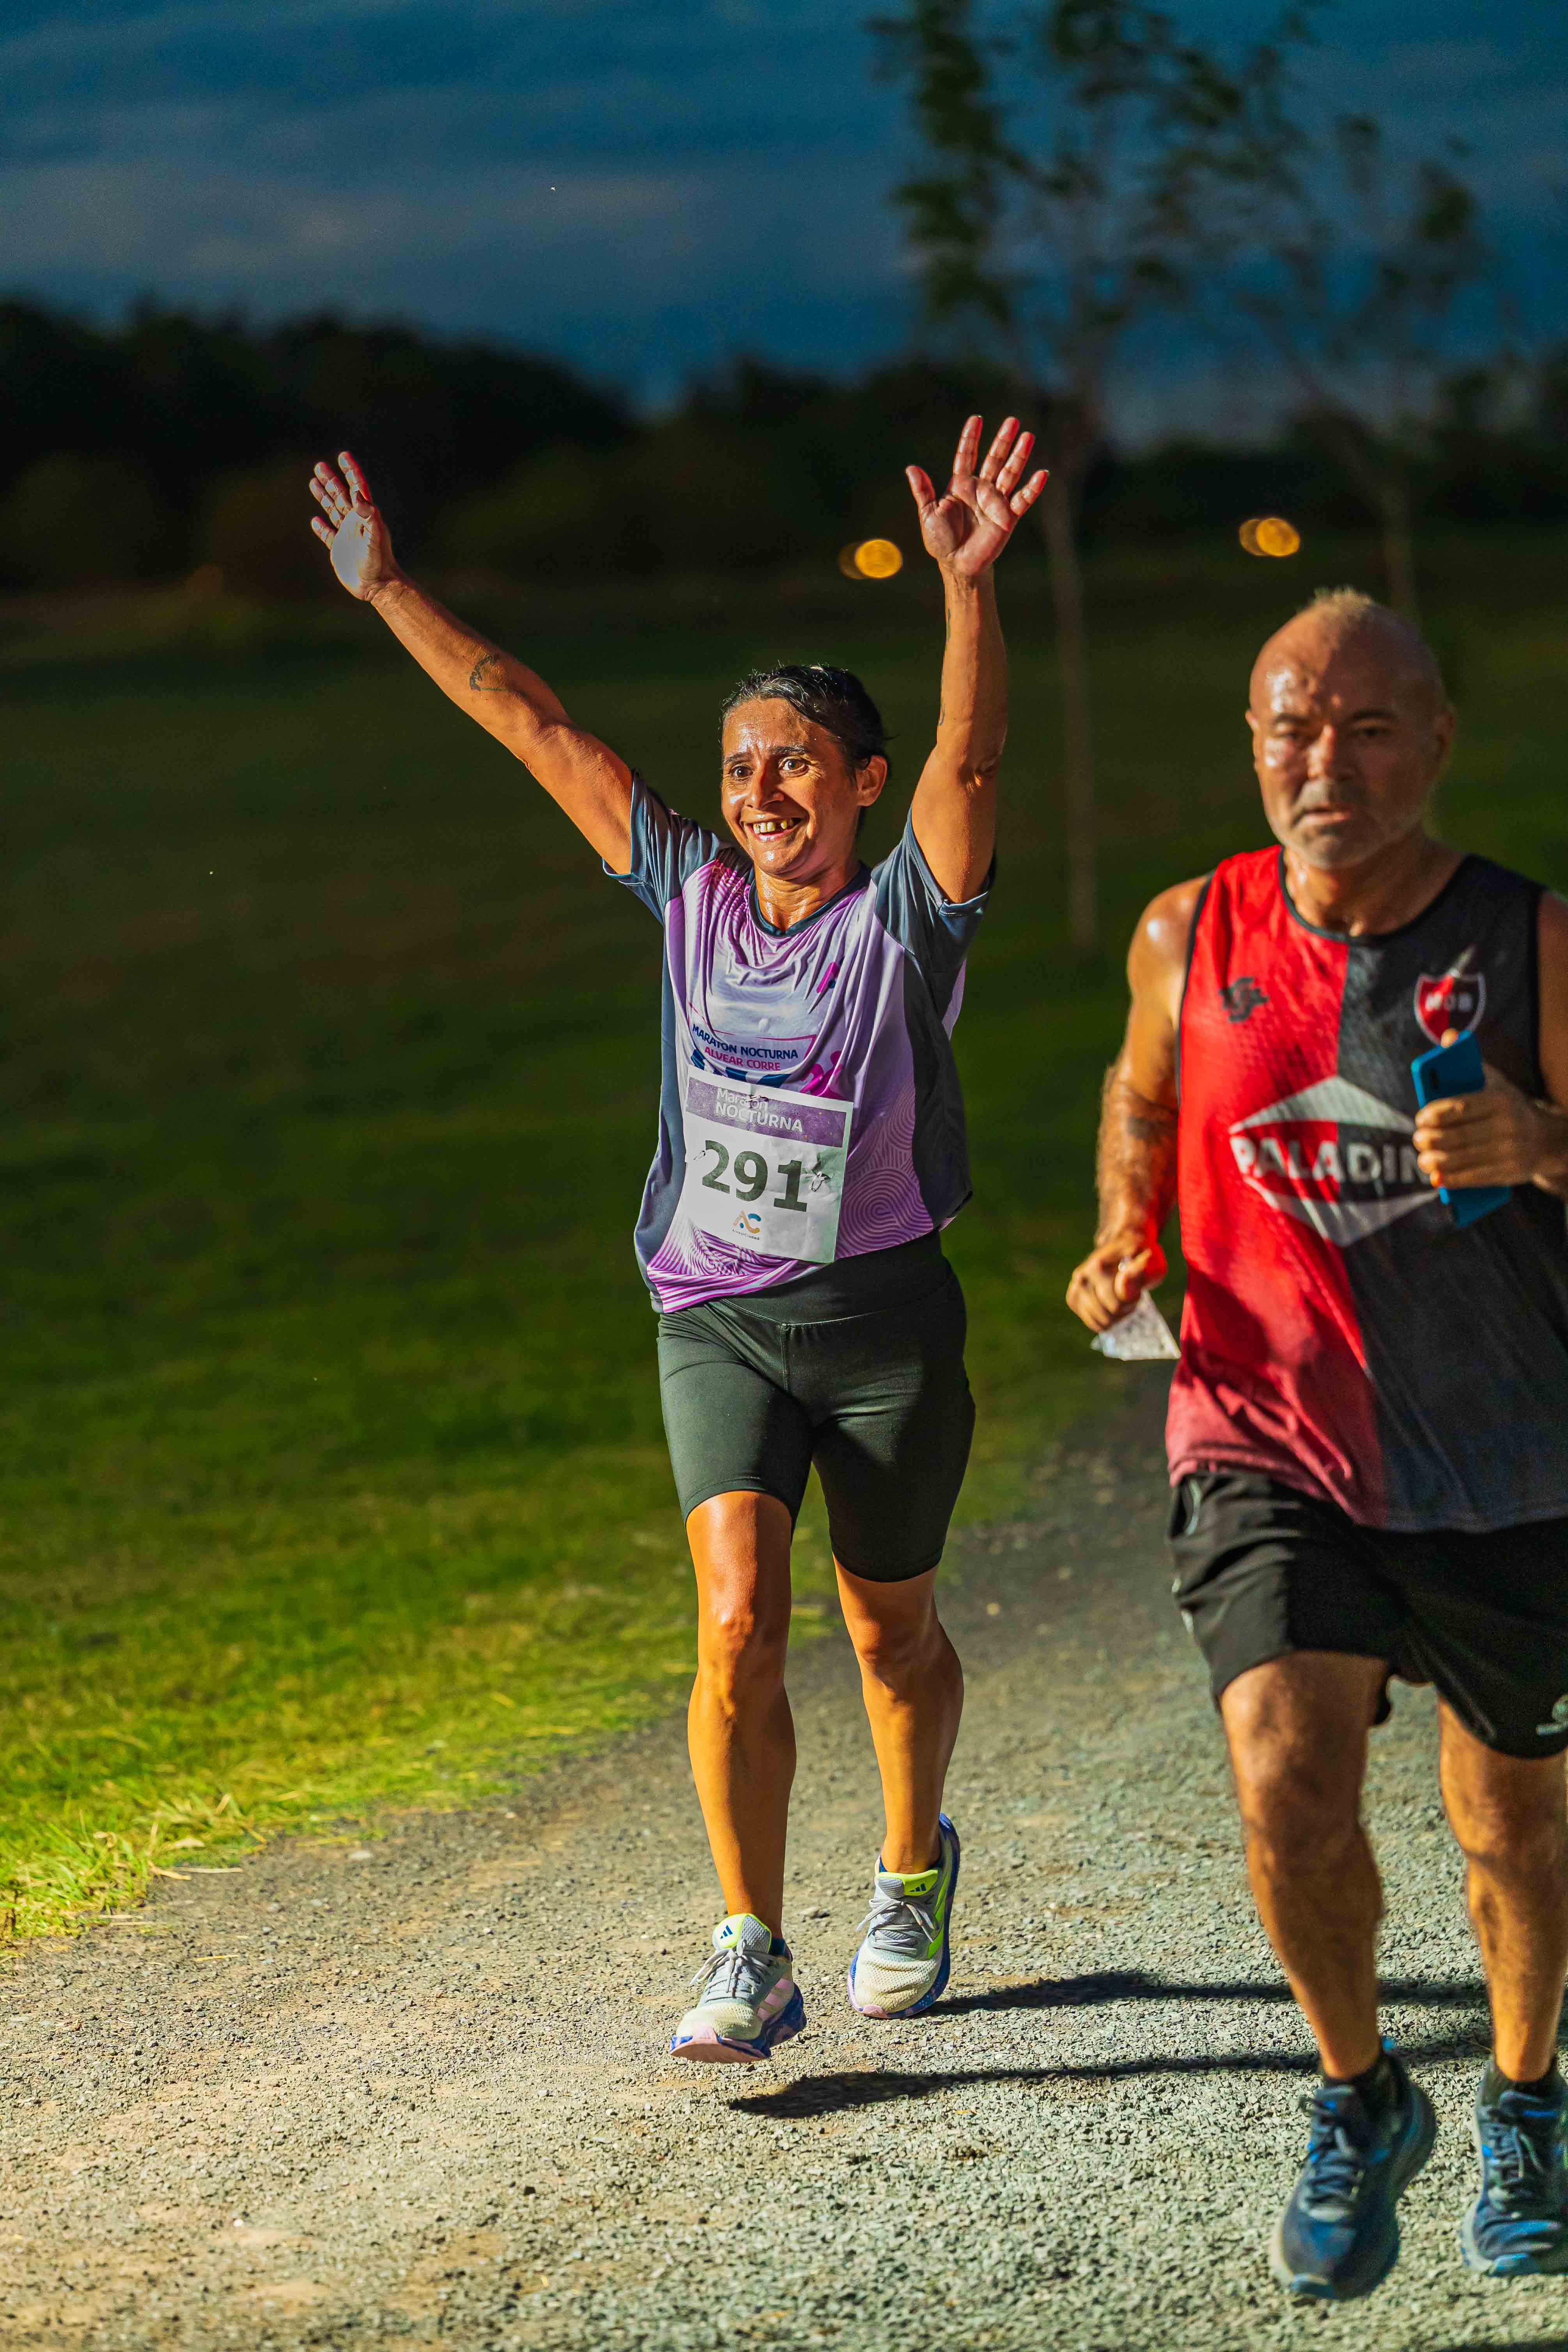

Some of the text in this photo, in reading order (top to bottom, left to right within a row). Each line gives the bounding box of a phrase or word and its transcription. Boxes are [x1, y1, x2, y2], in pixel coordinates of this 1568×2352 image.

[693, 1023, 798, 1059] MARATON NOCTURNA
[705, 1047, 780, 1071] ALVEAR CORRE
[717, 1087, 768, 1111] Maraon
[715, 1102, 803, 1133] NOCTURNA
[702, 1140, 808, 1212] 291
